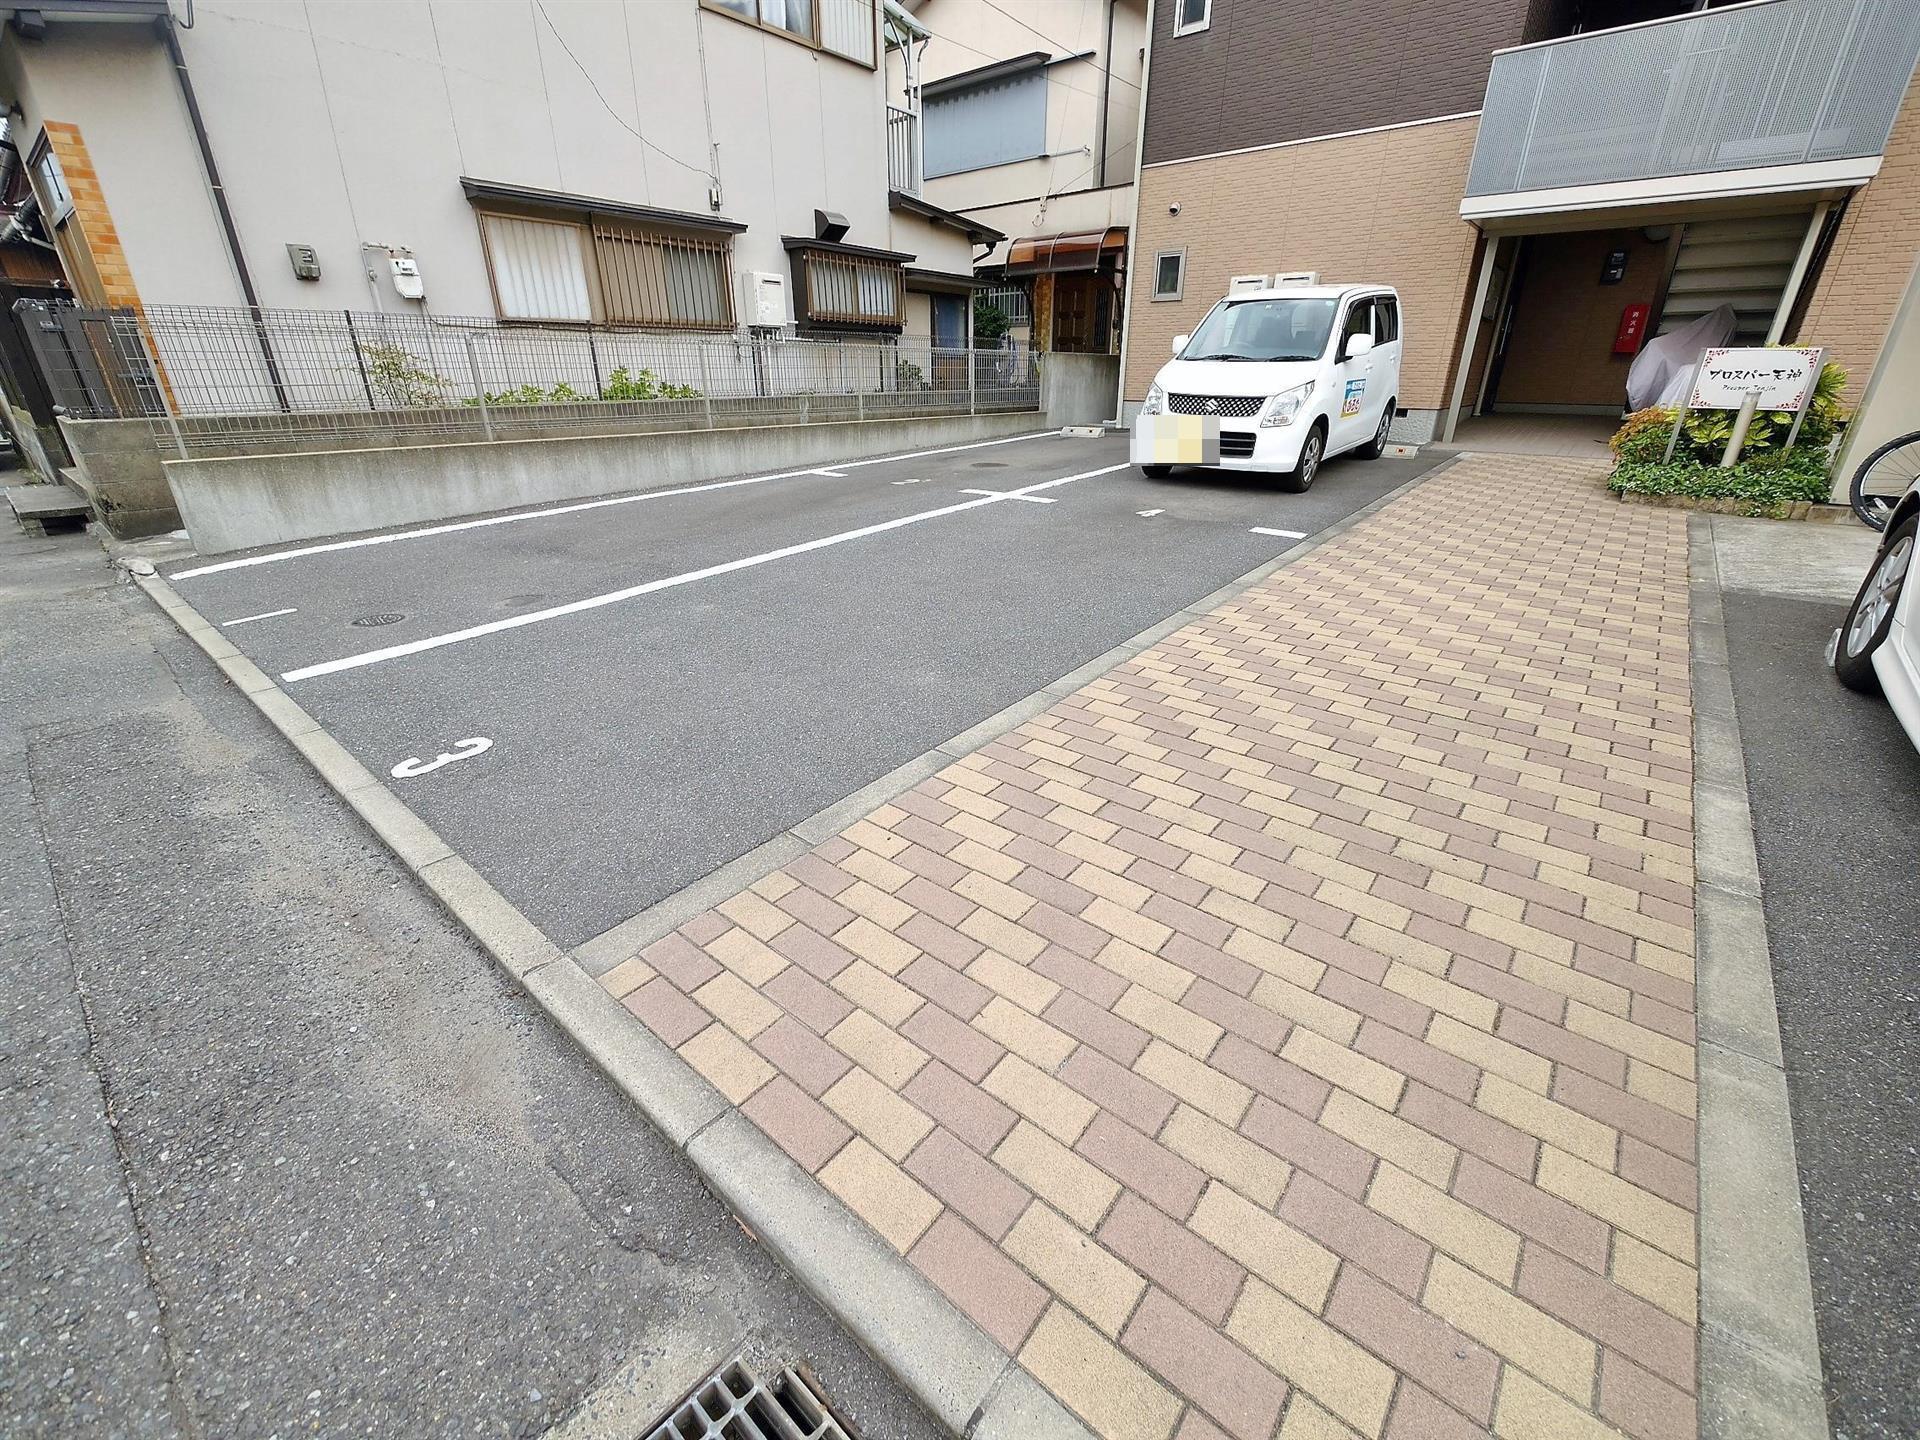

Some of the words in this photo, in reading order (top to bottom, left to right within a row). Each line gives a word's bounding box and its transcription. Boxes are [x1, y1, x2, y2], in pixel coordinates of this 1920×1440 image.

[1627, 311, 1640, 334] 消火器
[1709, 368, 1803, 382] プロスパー天神
[1753, 384, 1777, 392] Tenjin
[390, 736, 494, 779] 3
